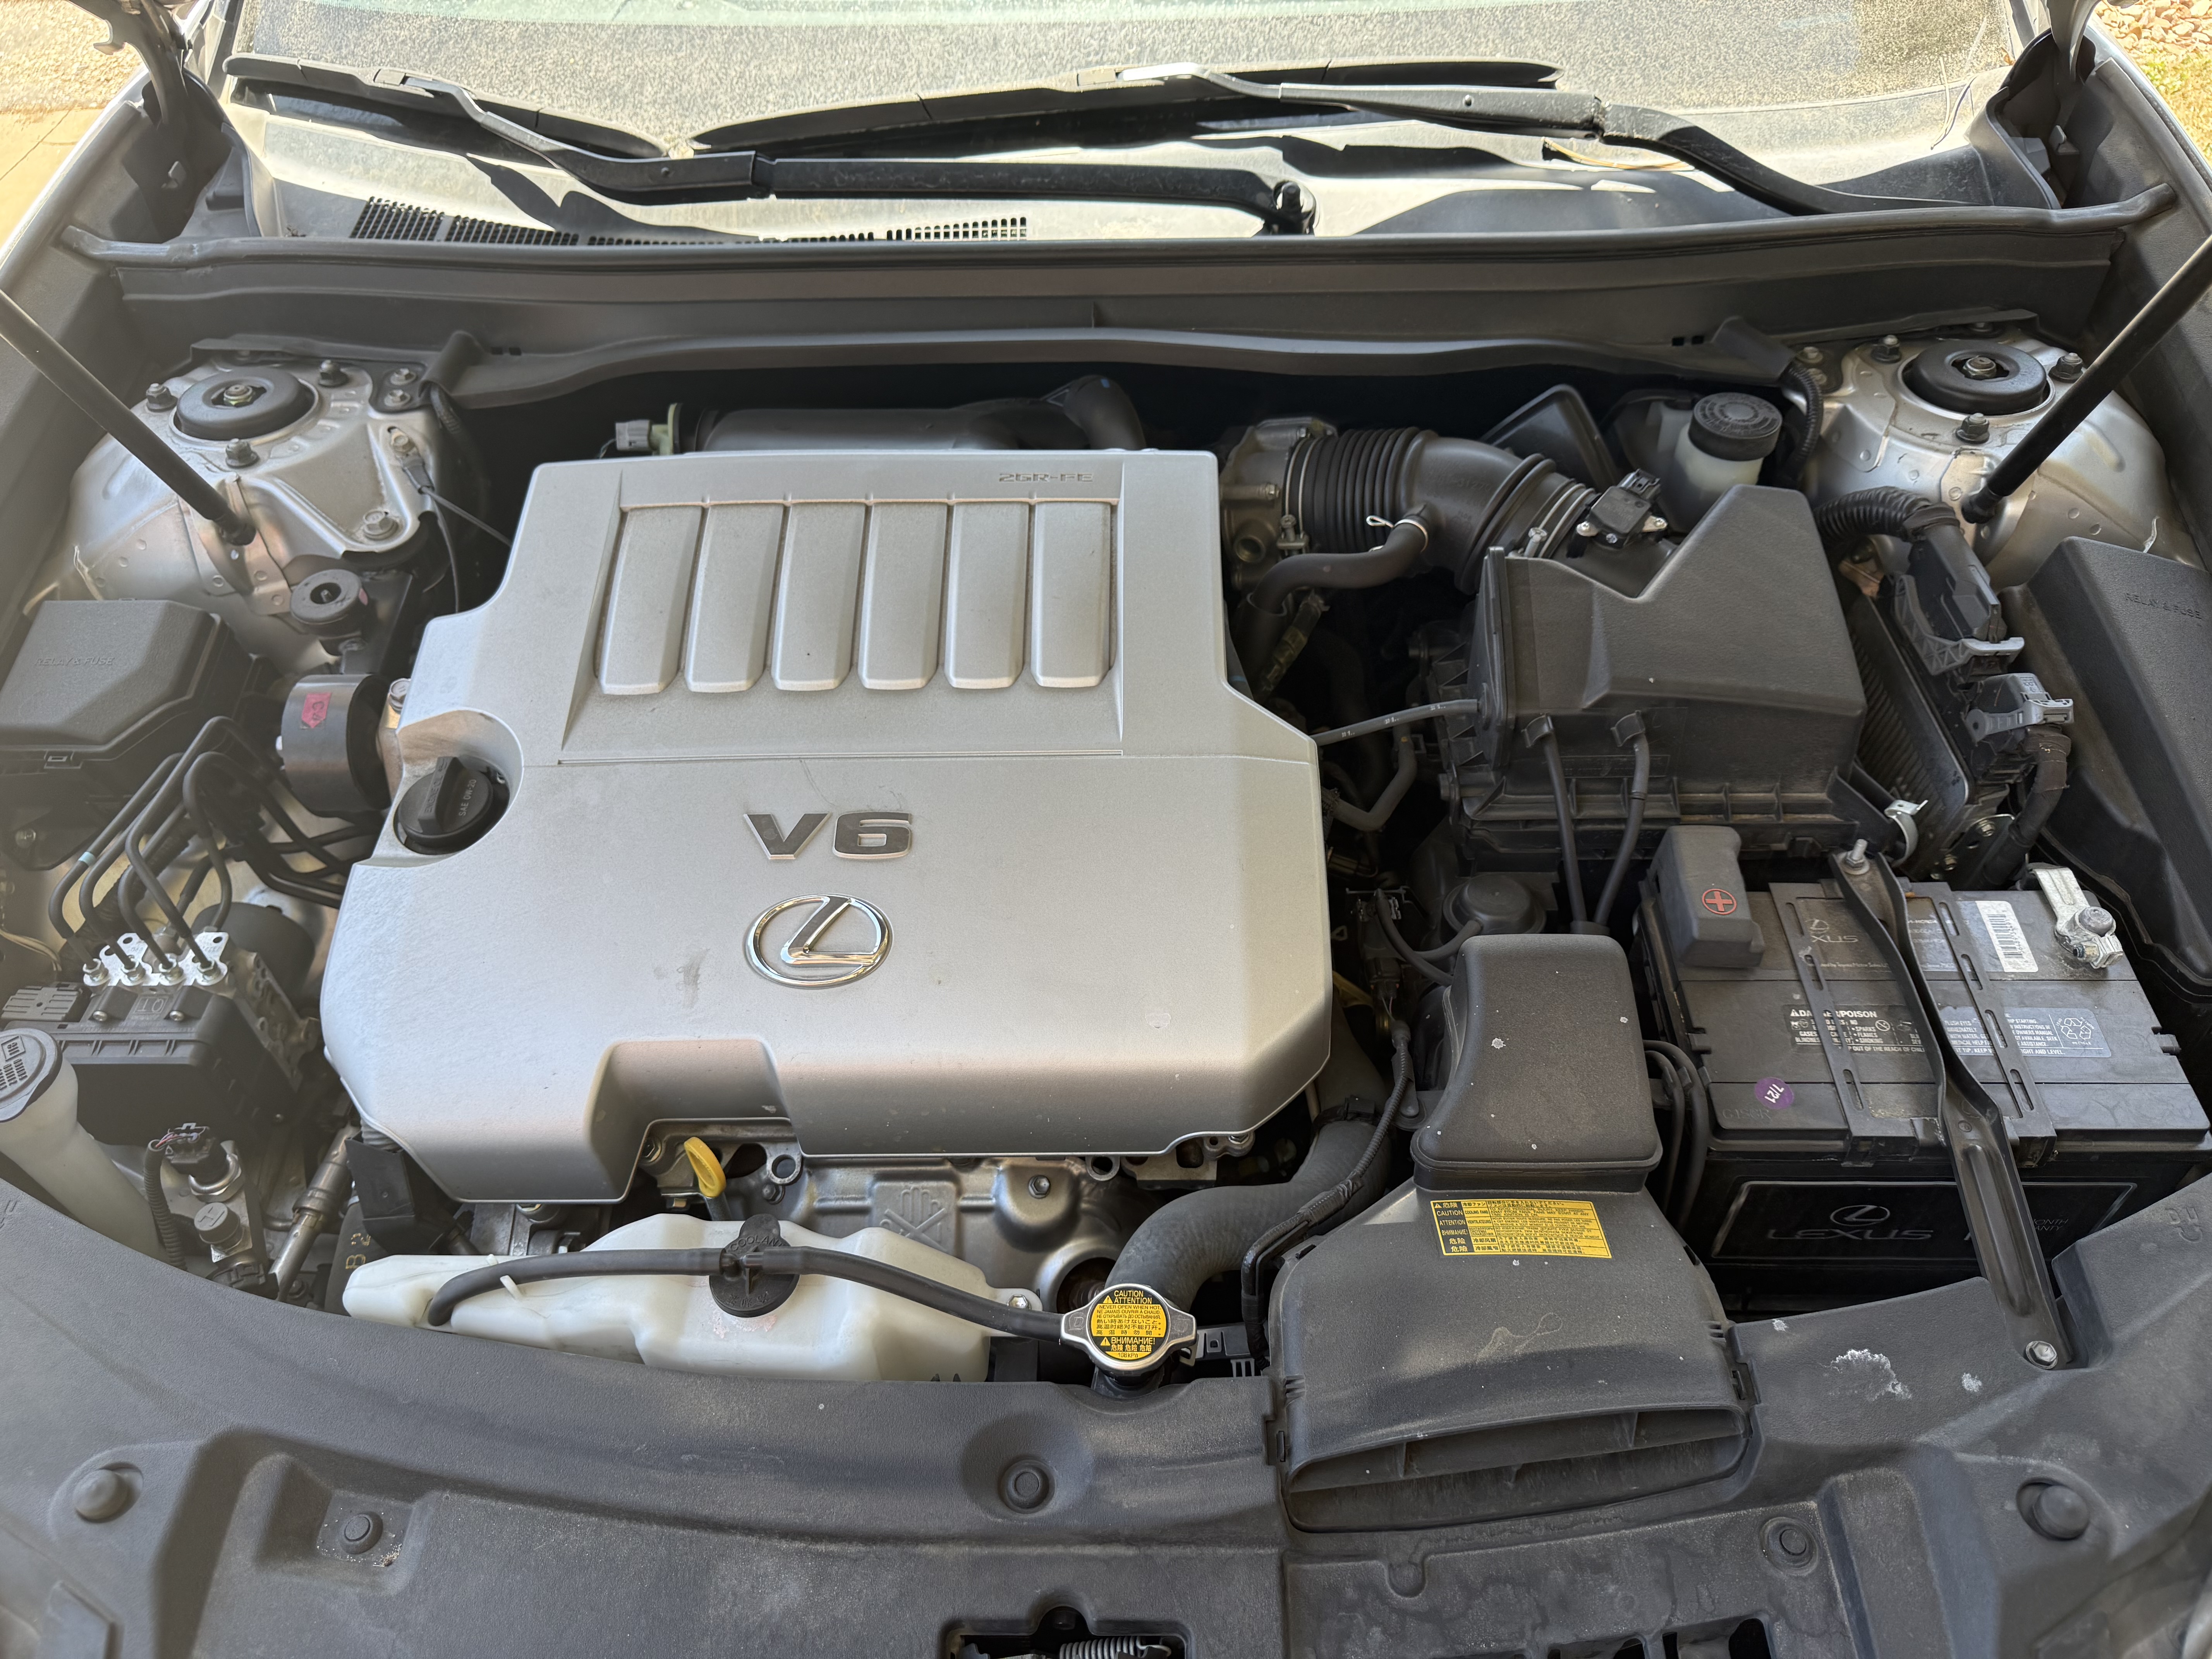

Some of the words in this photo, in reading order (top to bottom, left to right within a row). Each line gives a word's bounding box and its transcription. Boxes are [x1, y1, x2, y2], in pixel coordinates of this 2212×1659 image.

[999, 472, 1093, 483] 2GR-FE
[2124, 591, 2159, 609] RELAY
[2174, 604, 2203, 620] FUSE
[35, 657, 74, 666] RELAY
[74, 658, 81, 666] &
[84, 657, 115, 666] FUSE
[458, 802, 469, 816] SAE
[743, 811, 913, 860] V6
[1810, 934, 1859, 943] XUS
[1767, 1228, 1934, 1240] LEXUS
[1111, 1337, 1156, 1345] ВНИМАНИЕ!
